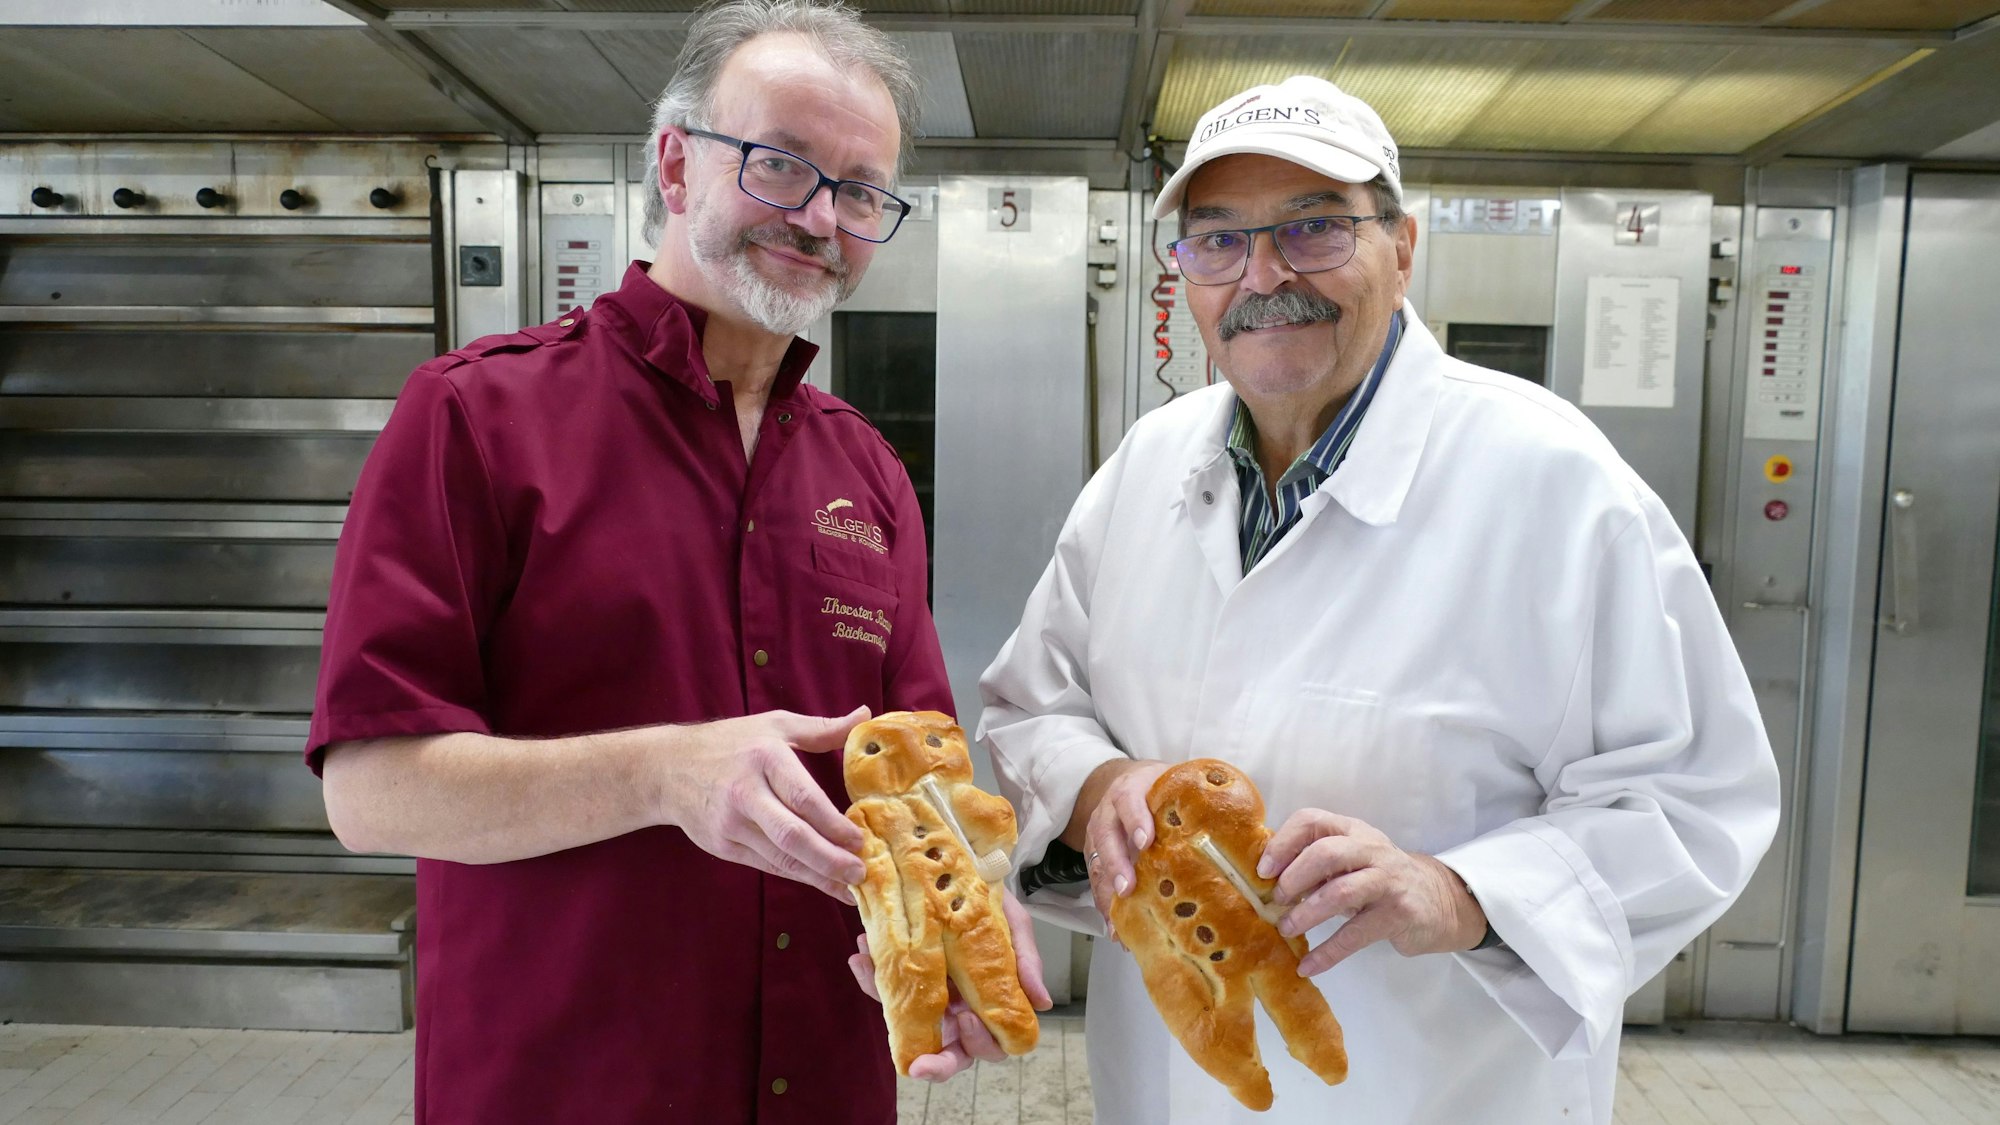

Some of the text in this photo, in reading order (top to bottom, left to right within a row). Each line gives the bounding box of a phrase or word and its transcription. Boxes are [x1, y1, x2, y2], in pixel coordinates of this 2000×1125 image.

[1199, 106, 1321, 143] GILGEN'S
[1000, 191, 1017, 227] 5
[1627, 204, 1644, 242] 4
[815, 509, 882, 543] GILGEN'S
[821, 596, 874, 621] Thorsten
